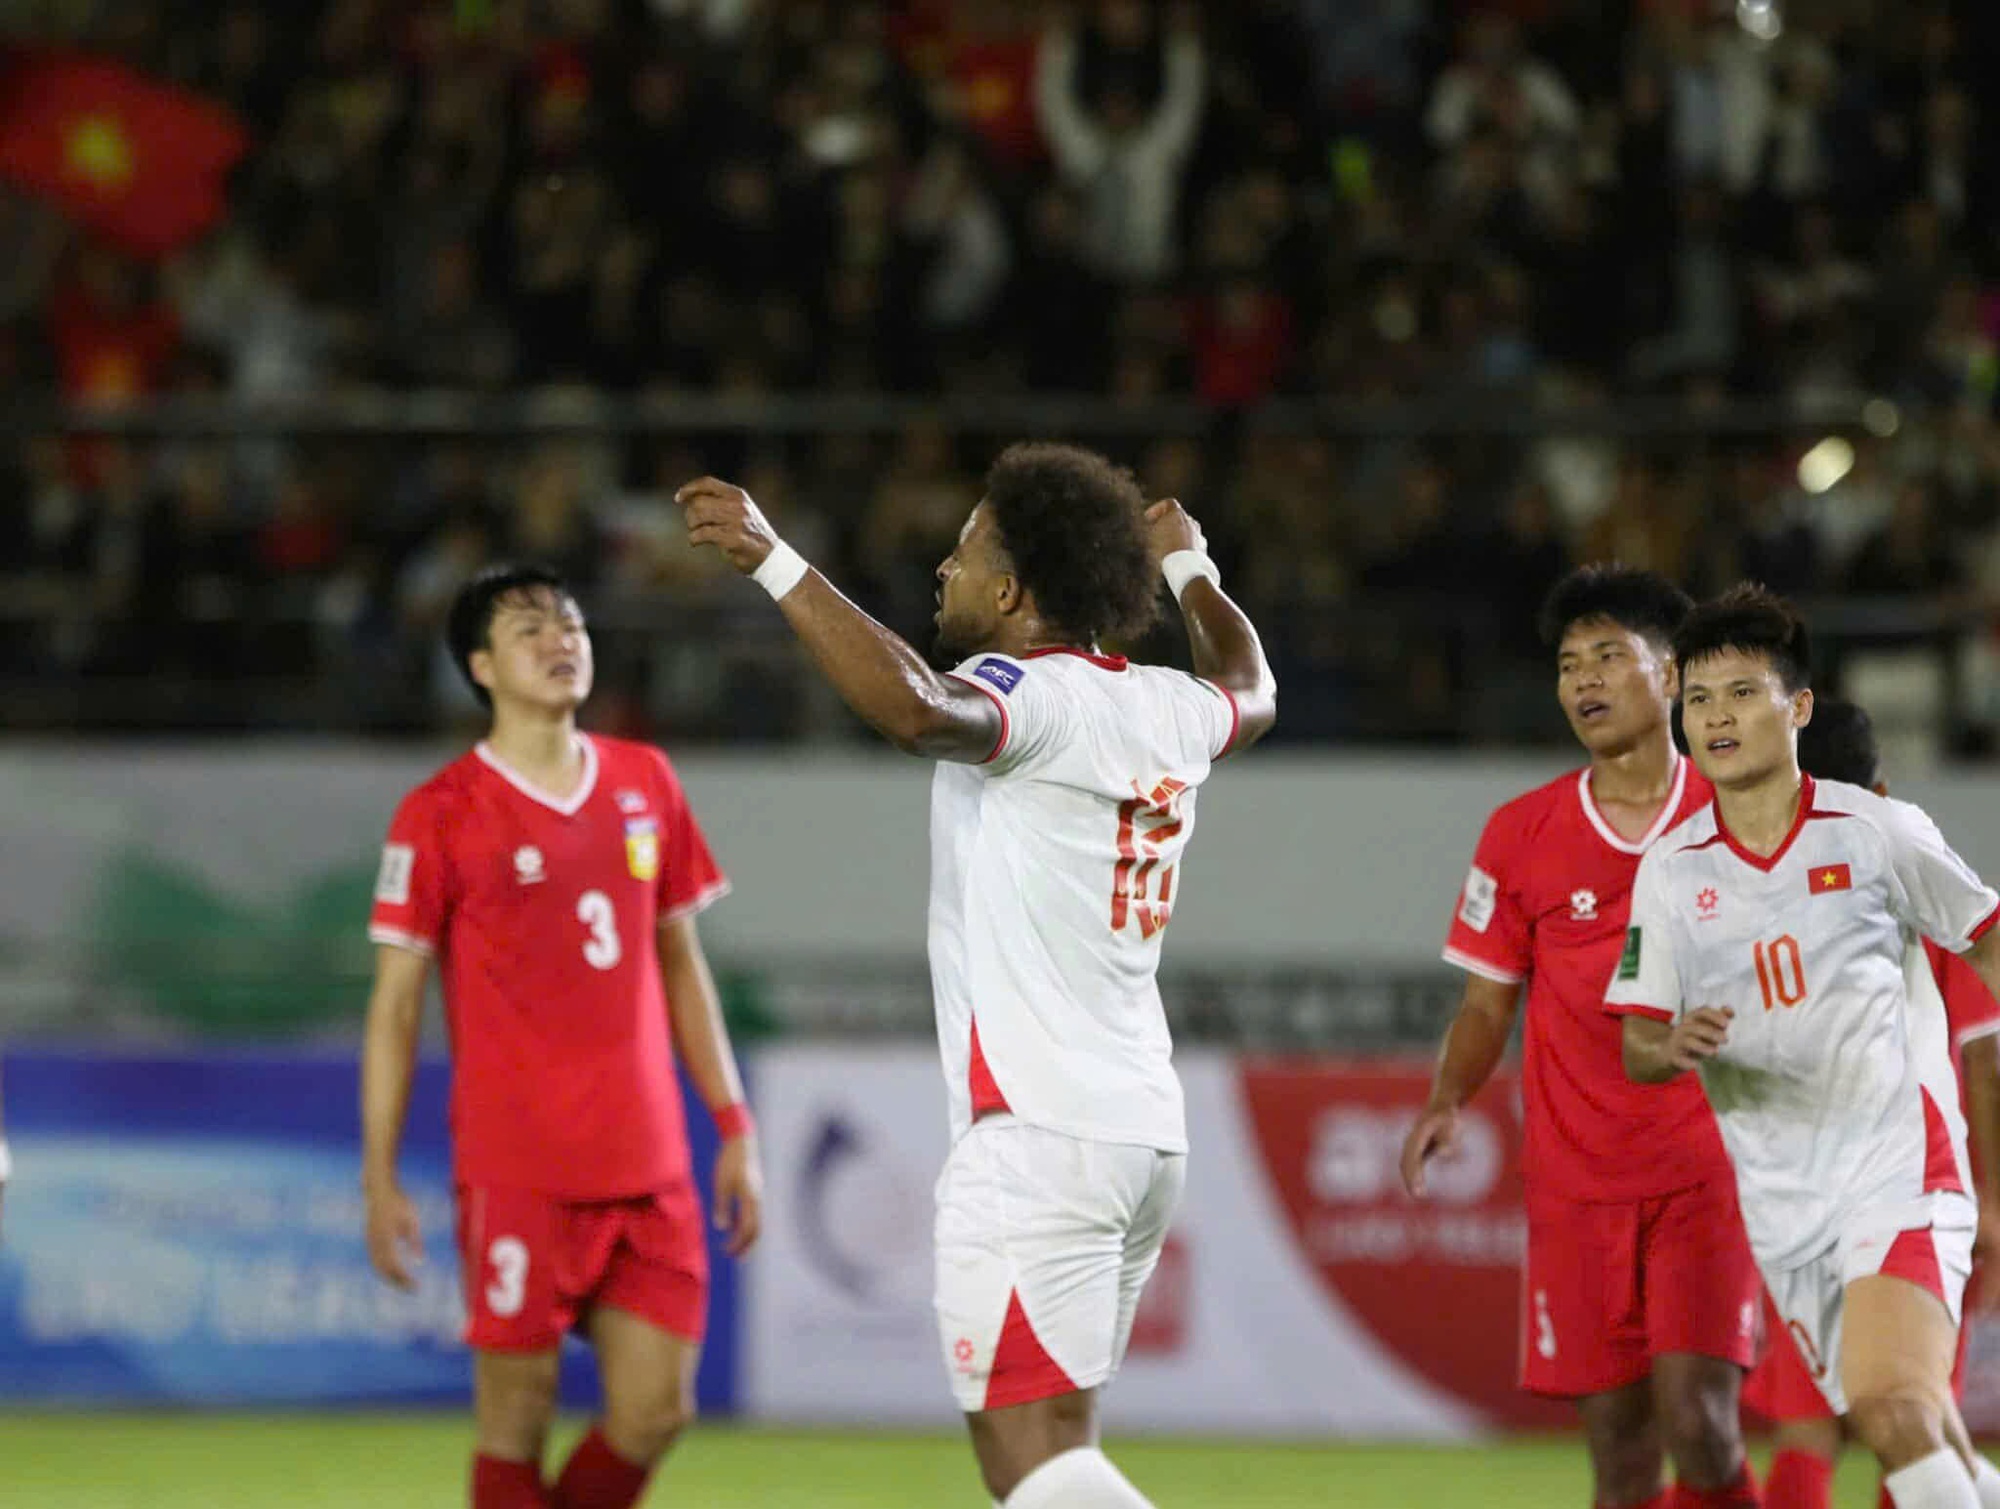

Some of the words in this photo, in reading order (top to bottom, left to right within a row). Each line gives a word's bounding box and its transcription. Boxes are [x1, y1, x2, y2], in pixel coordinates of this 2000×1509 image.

[979, 665, 1016, 687] AFC
[576, 887, 621, 970] 3
[1752, 933, 1807, 1013] 10
[485, 1236, 529, 1316] 3
